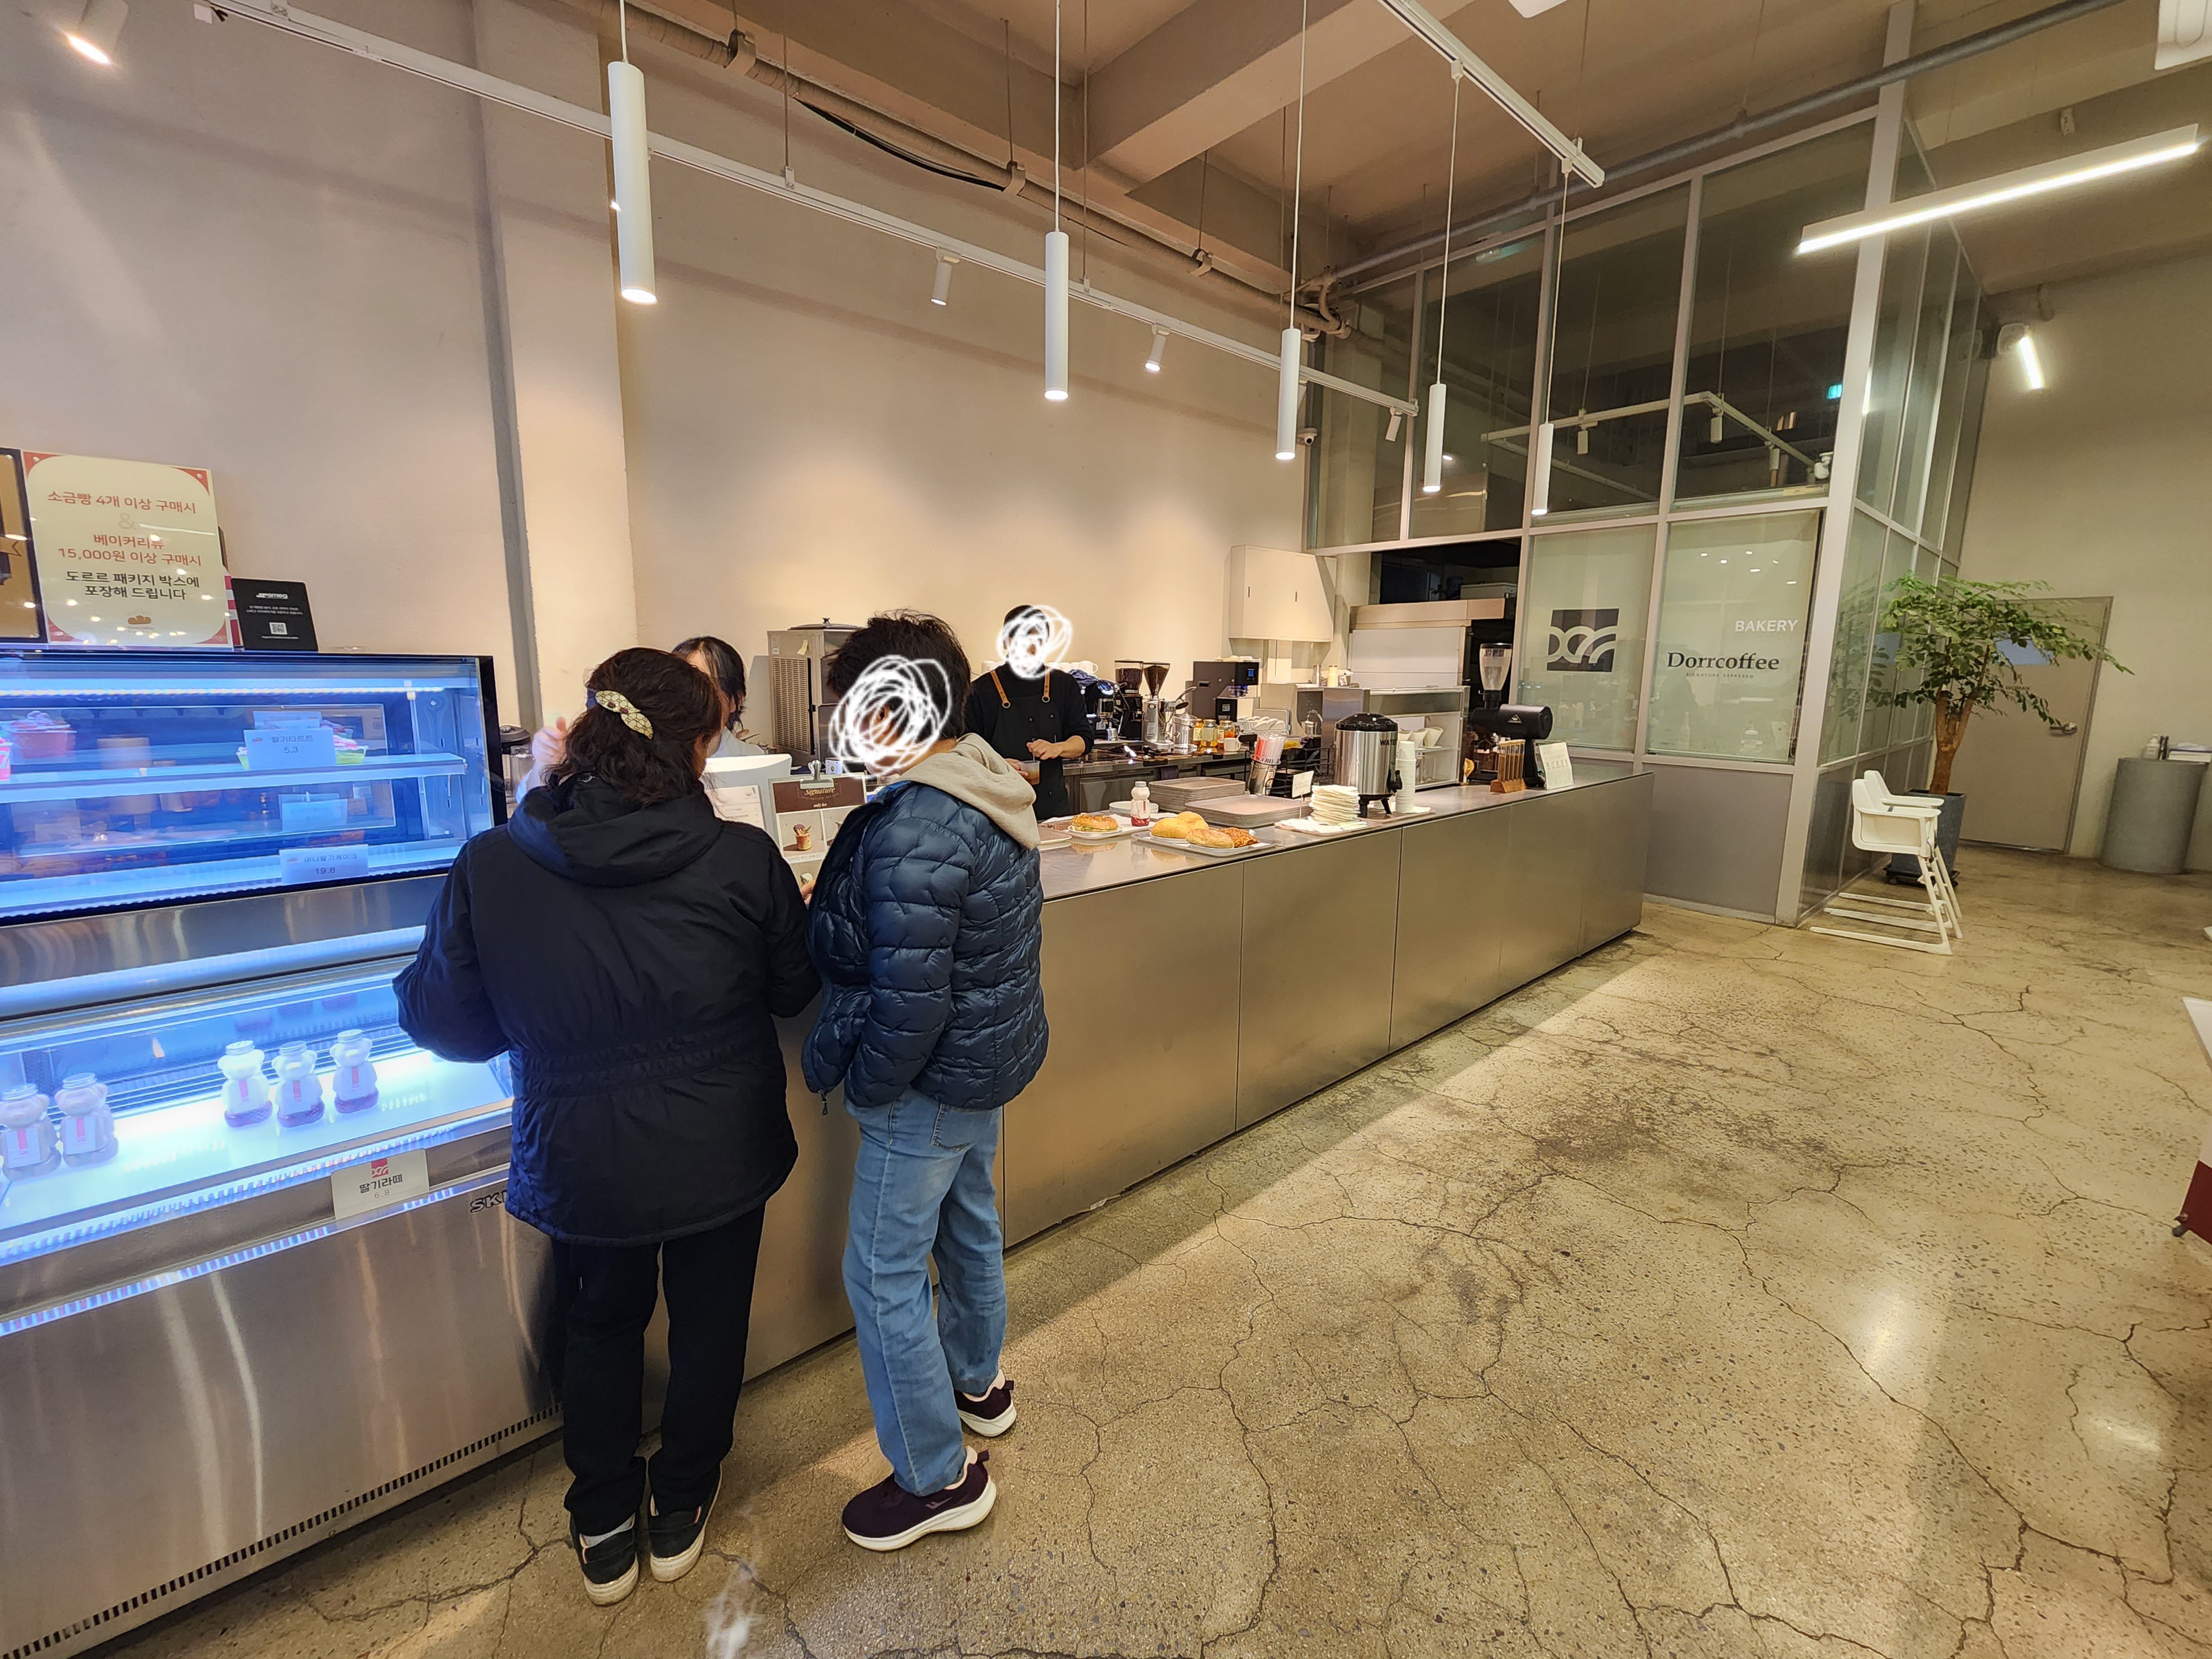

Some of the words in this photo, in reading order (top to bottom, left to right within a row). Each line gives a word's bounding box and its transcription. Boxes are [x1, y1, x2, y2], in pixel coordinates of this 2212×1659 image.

[48, 491, 92, 505] 소금빵
[96, 495, 120, 508] 4개
[124, 498, 152, 510] 이상
[155, 500, 196, 514] 구매시
[58, 549, 126, 562] 15,000원
[130, 552, 157, 565] 이상
[161, 554, 202, 566] 구매시
[66, 571, 111, 582] 도르르
[113, 573, 155, 586] 패키지
[159, 575, 200, 588] 박스에
[85, 586, 128, 598] 포장해
[131, 587, 186, 600] 드립니다
[1735, 619, 1798, 632] BAKERY
[1667, 652, 1780, 670] Dorrcoffee
[315, 867, 336, 875] 19.8
[359, 1173, 403, 1194] 딸기라떼
[374, 1189, 390, 1199] 6.8
